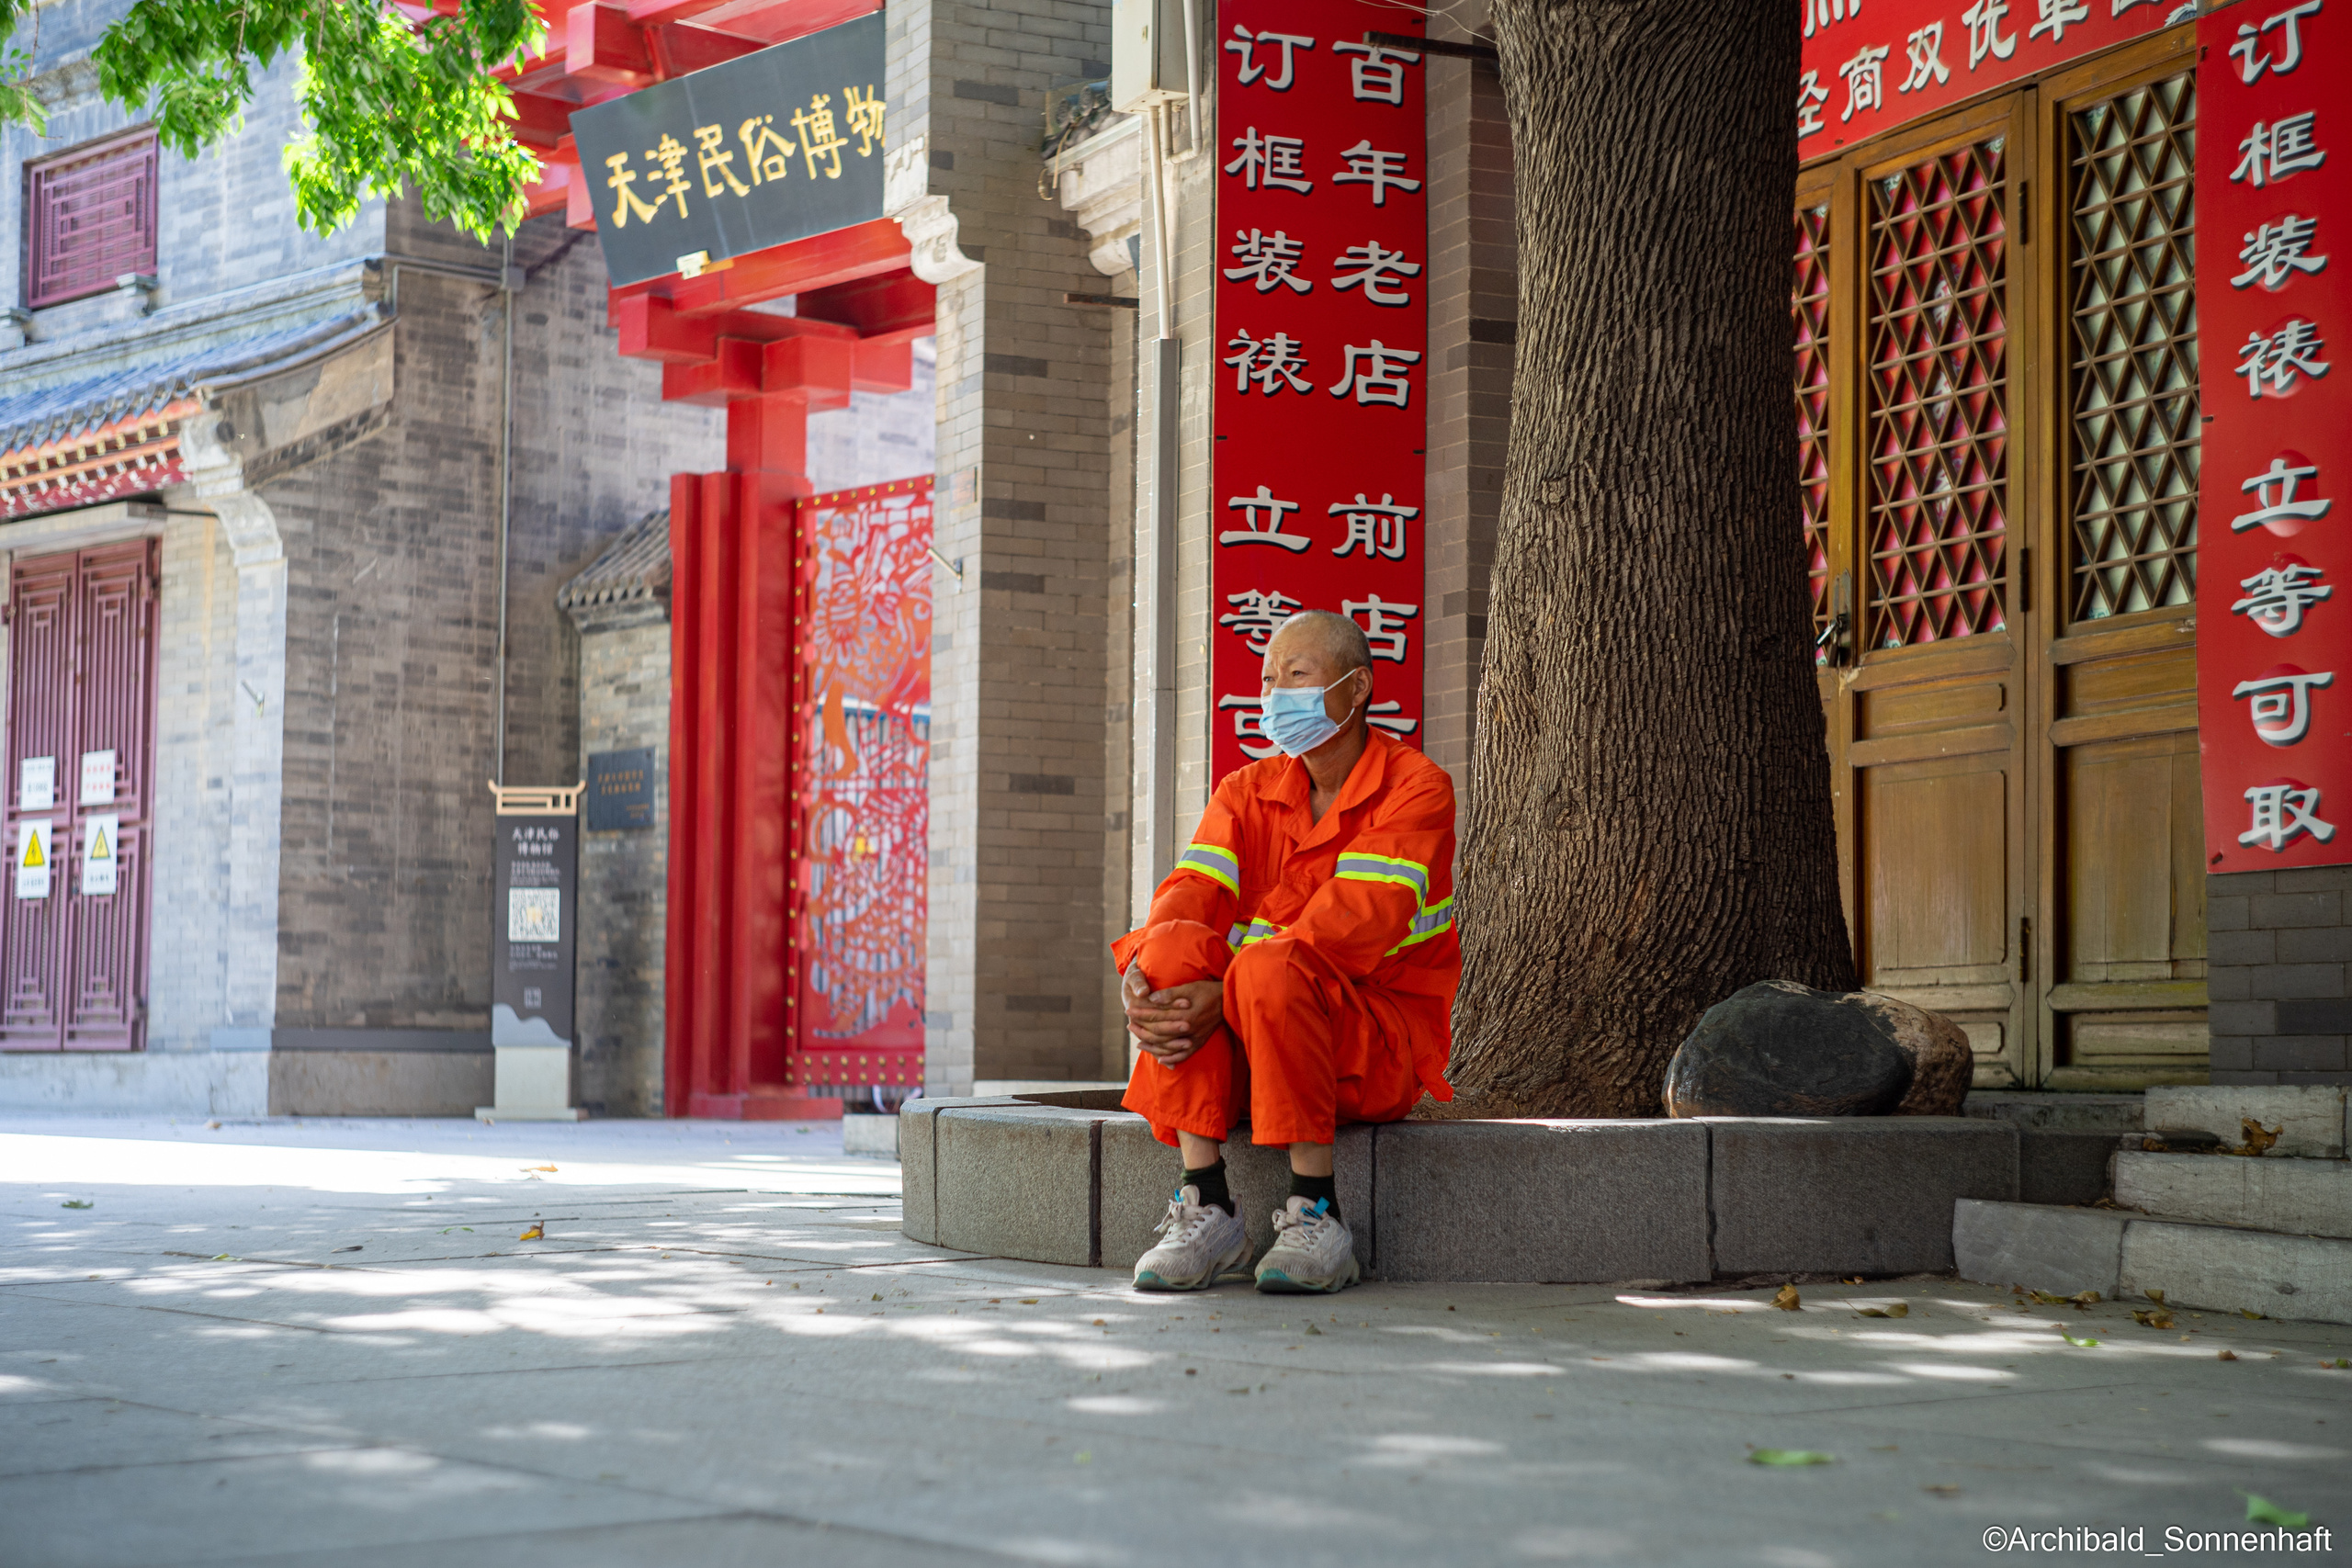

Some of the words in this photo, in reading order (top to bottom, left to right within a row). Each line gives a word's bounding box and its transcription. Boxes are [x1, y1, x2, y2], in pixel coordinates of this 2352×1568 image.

[1224, 24, 1316, 395] 订框装裱
[1329, 39, 1422, 407] 百年老店
[2229, 0, 2330, 400] 订框装裱
[2231, 458, 2335, 852] 立等可取
